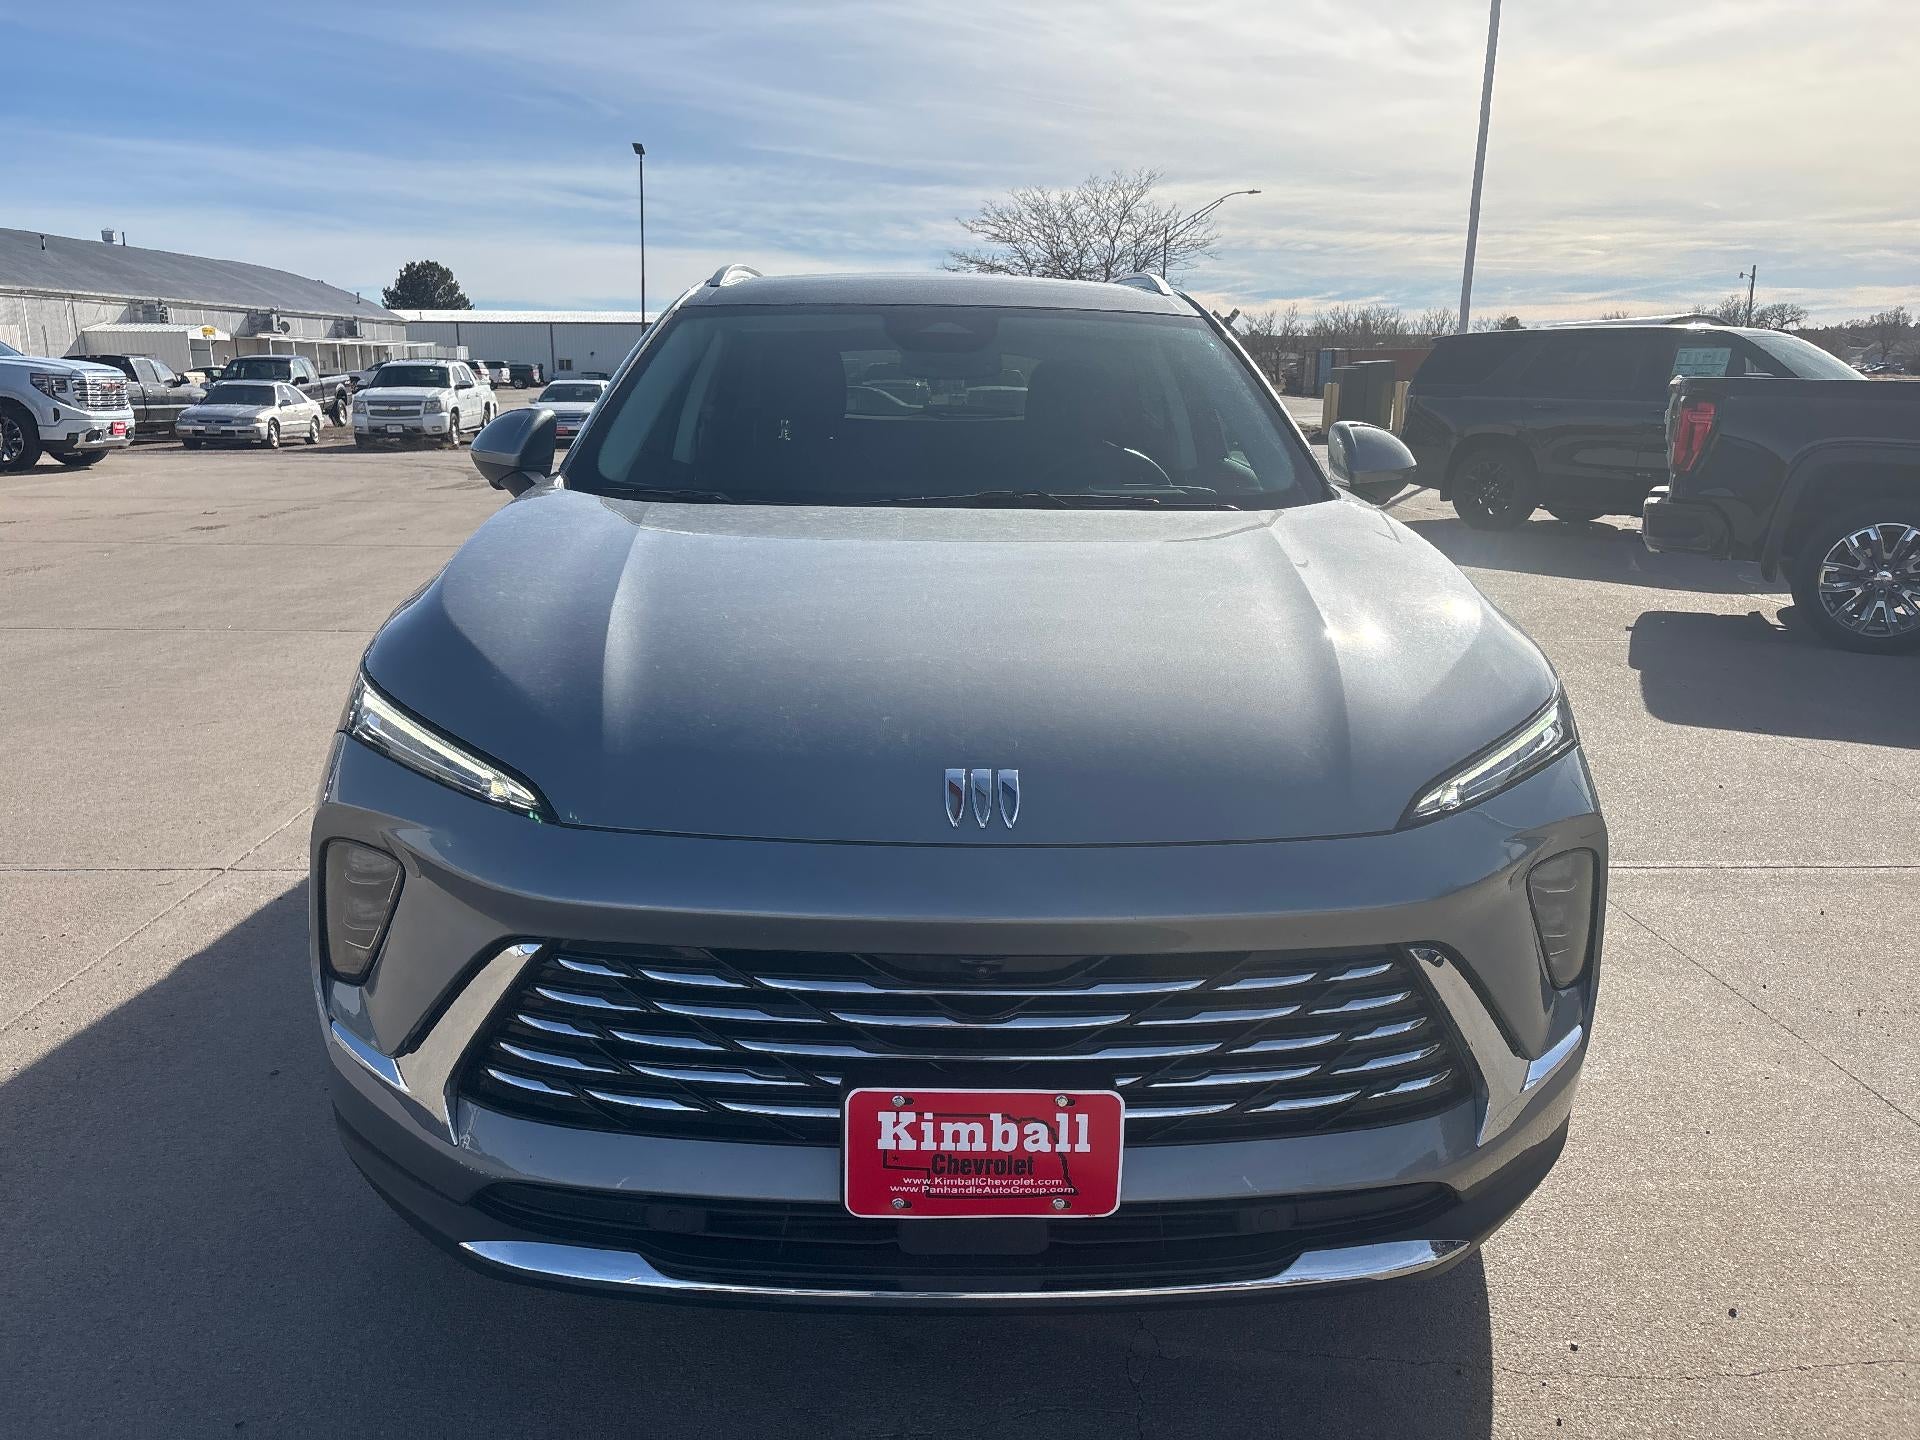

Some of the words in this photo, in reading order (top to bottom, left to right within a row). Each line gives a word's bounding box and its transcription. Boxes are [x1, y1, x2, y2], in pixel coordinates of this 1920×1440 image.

[877, 1111, 1091, 1153] Kimball
[931, 1153, 1035, 1175] Chevrolet
[902, 1177, 1063, 1186] www.KimballChevrolet.com
[889, 1185, 1075, 1195] www.PanhandleAutoGroup.com
